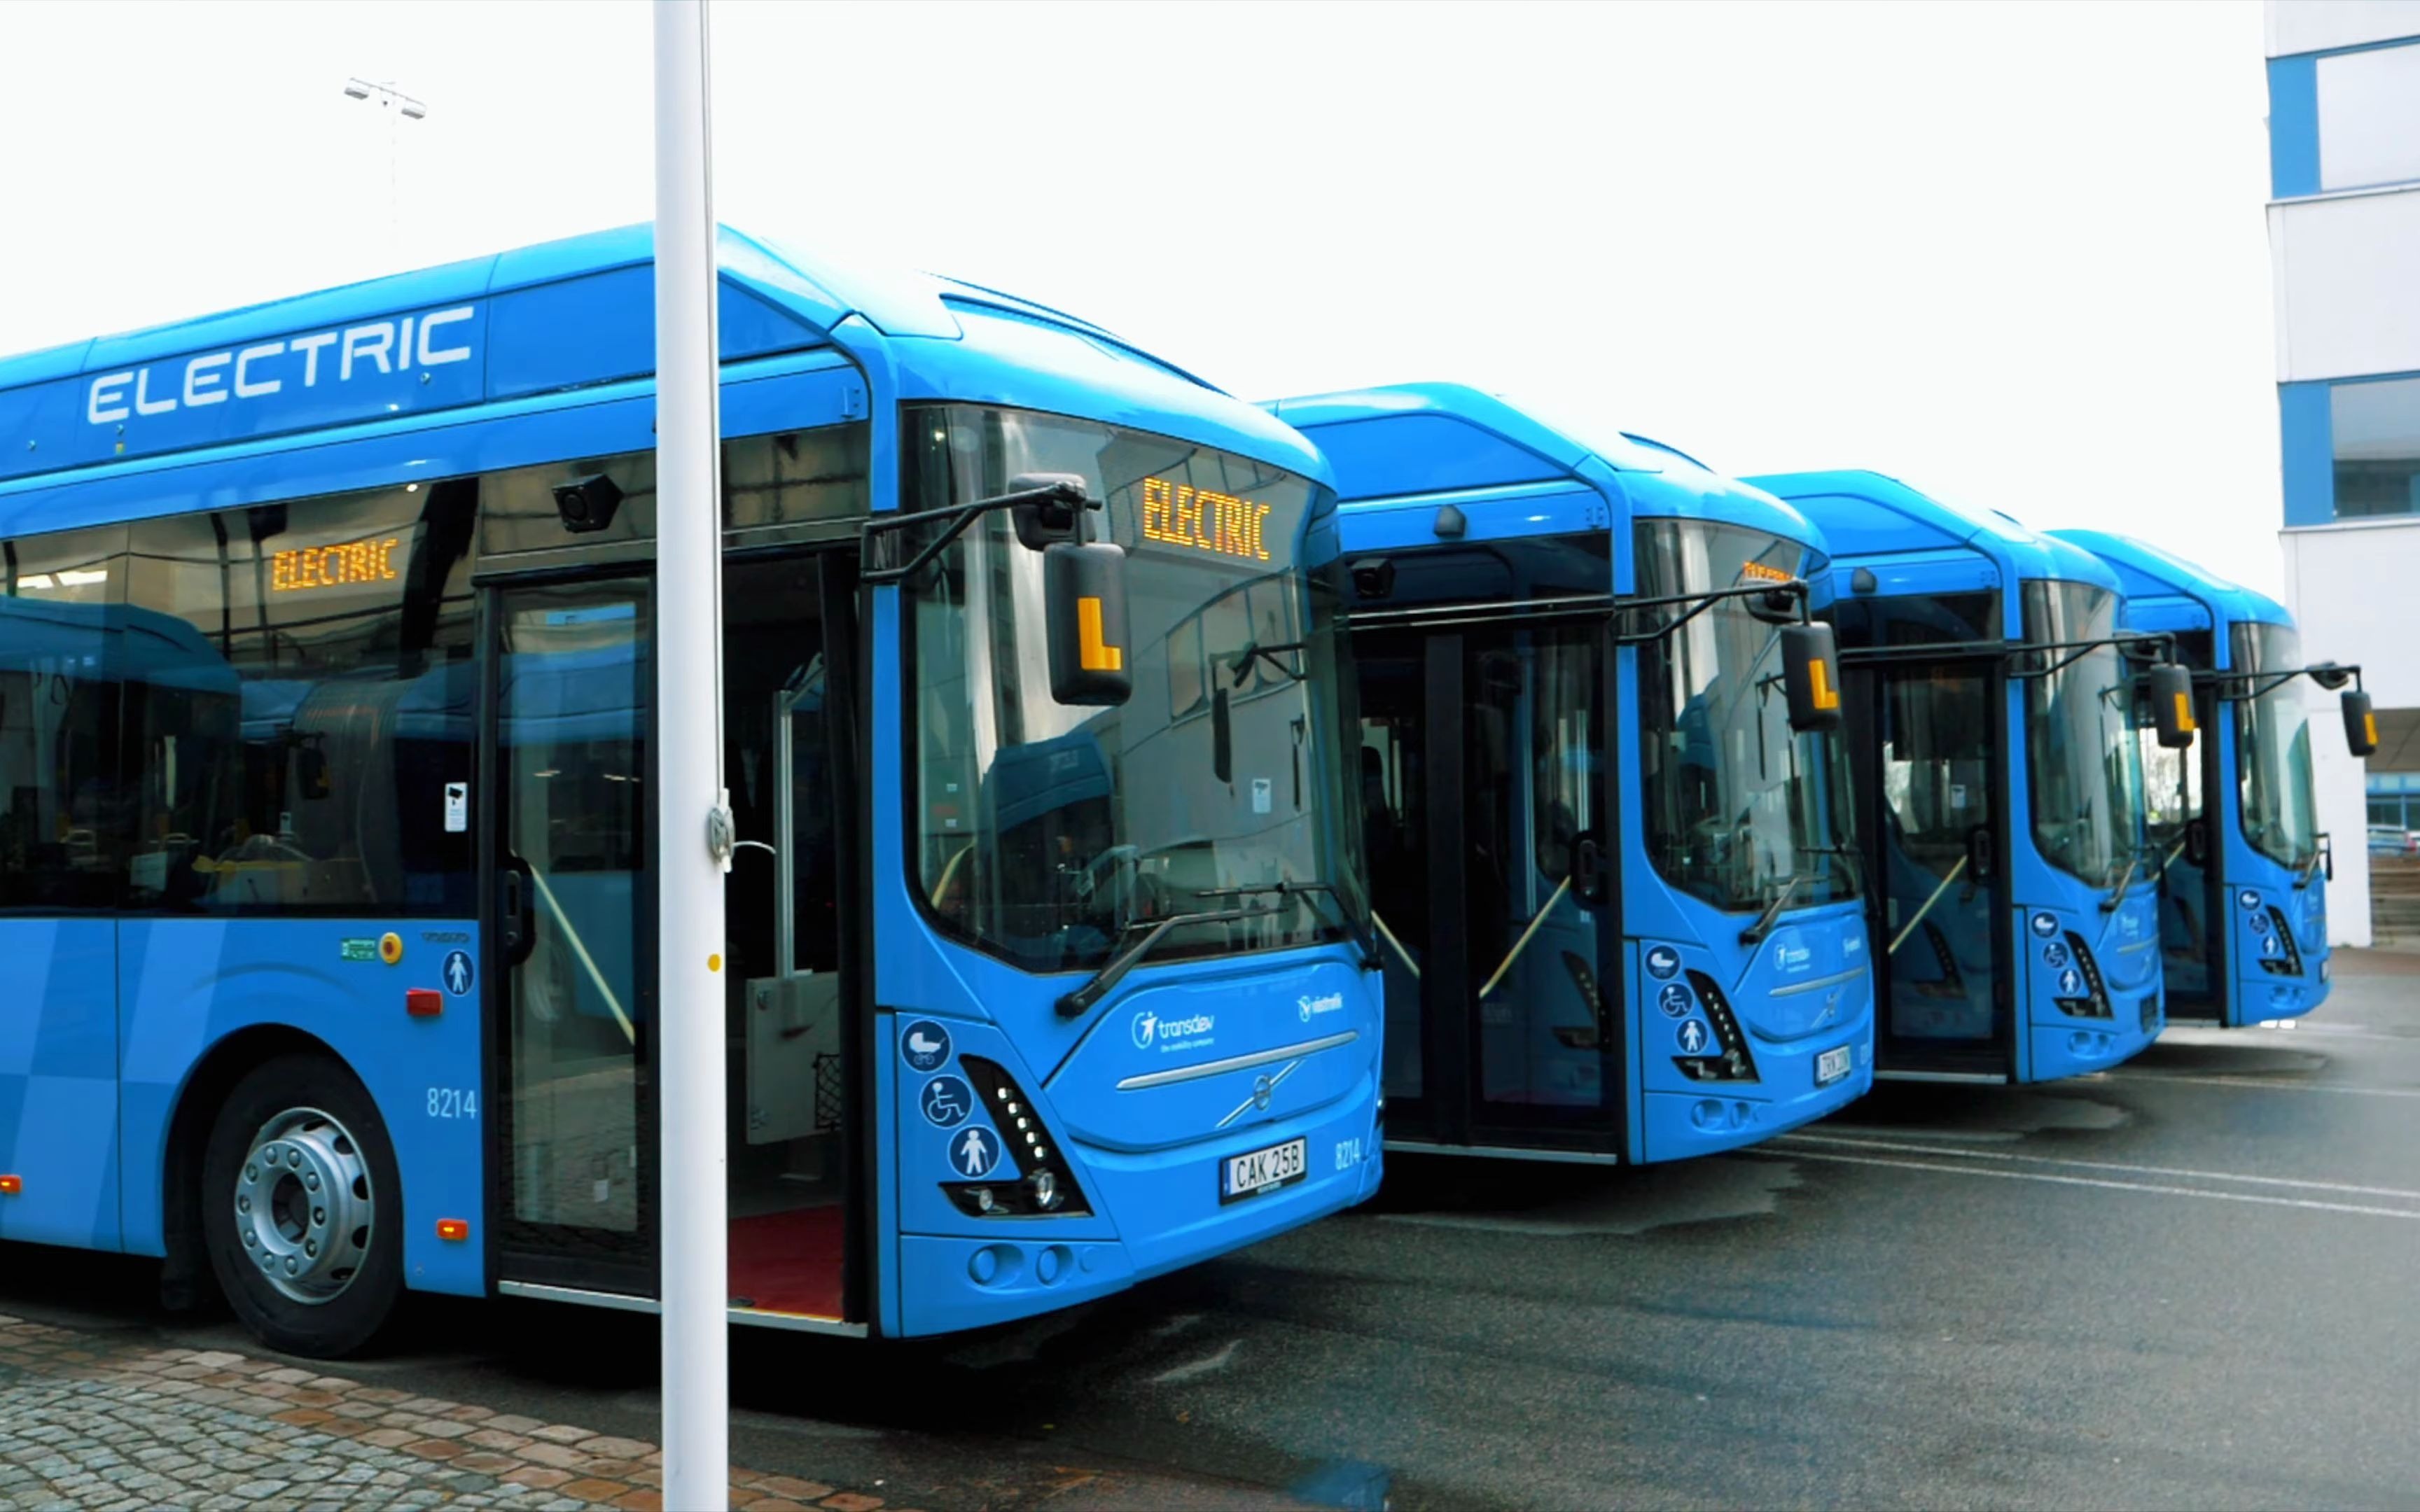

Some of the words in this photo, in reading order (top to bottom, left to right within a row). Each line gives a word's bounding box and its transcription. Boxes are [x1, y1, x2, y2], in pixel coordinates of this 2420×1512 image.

[87, 306, 475, 424] ELECTRIC
[1143, 477, 1271, 561] ELECTRIC
[272, 537, 398, 591] ELECTRIC
[426, 1087, 478, 1120] 8214
[1237, 1154, 1267, 1188] CAK
[1335, 1138, 1361, 1171] 8214
